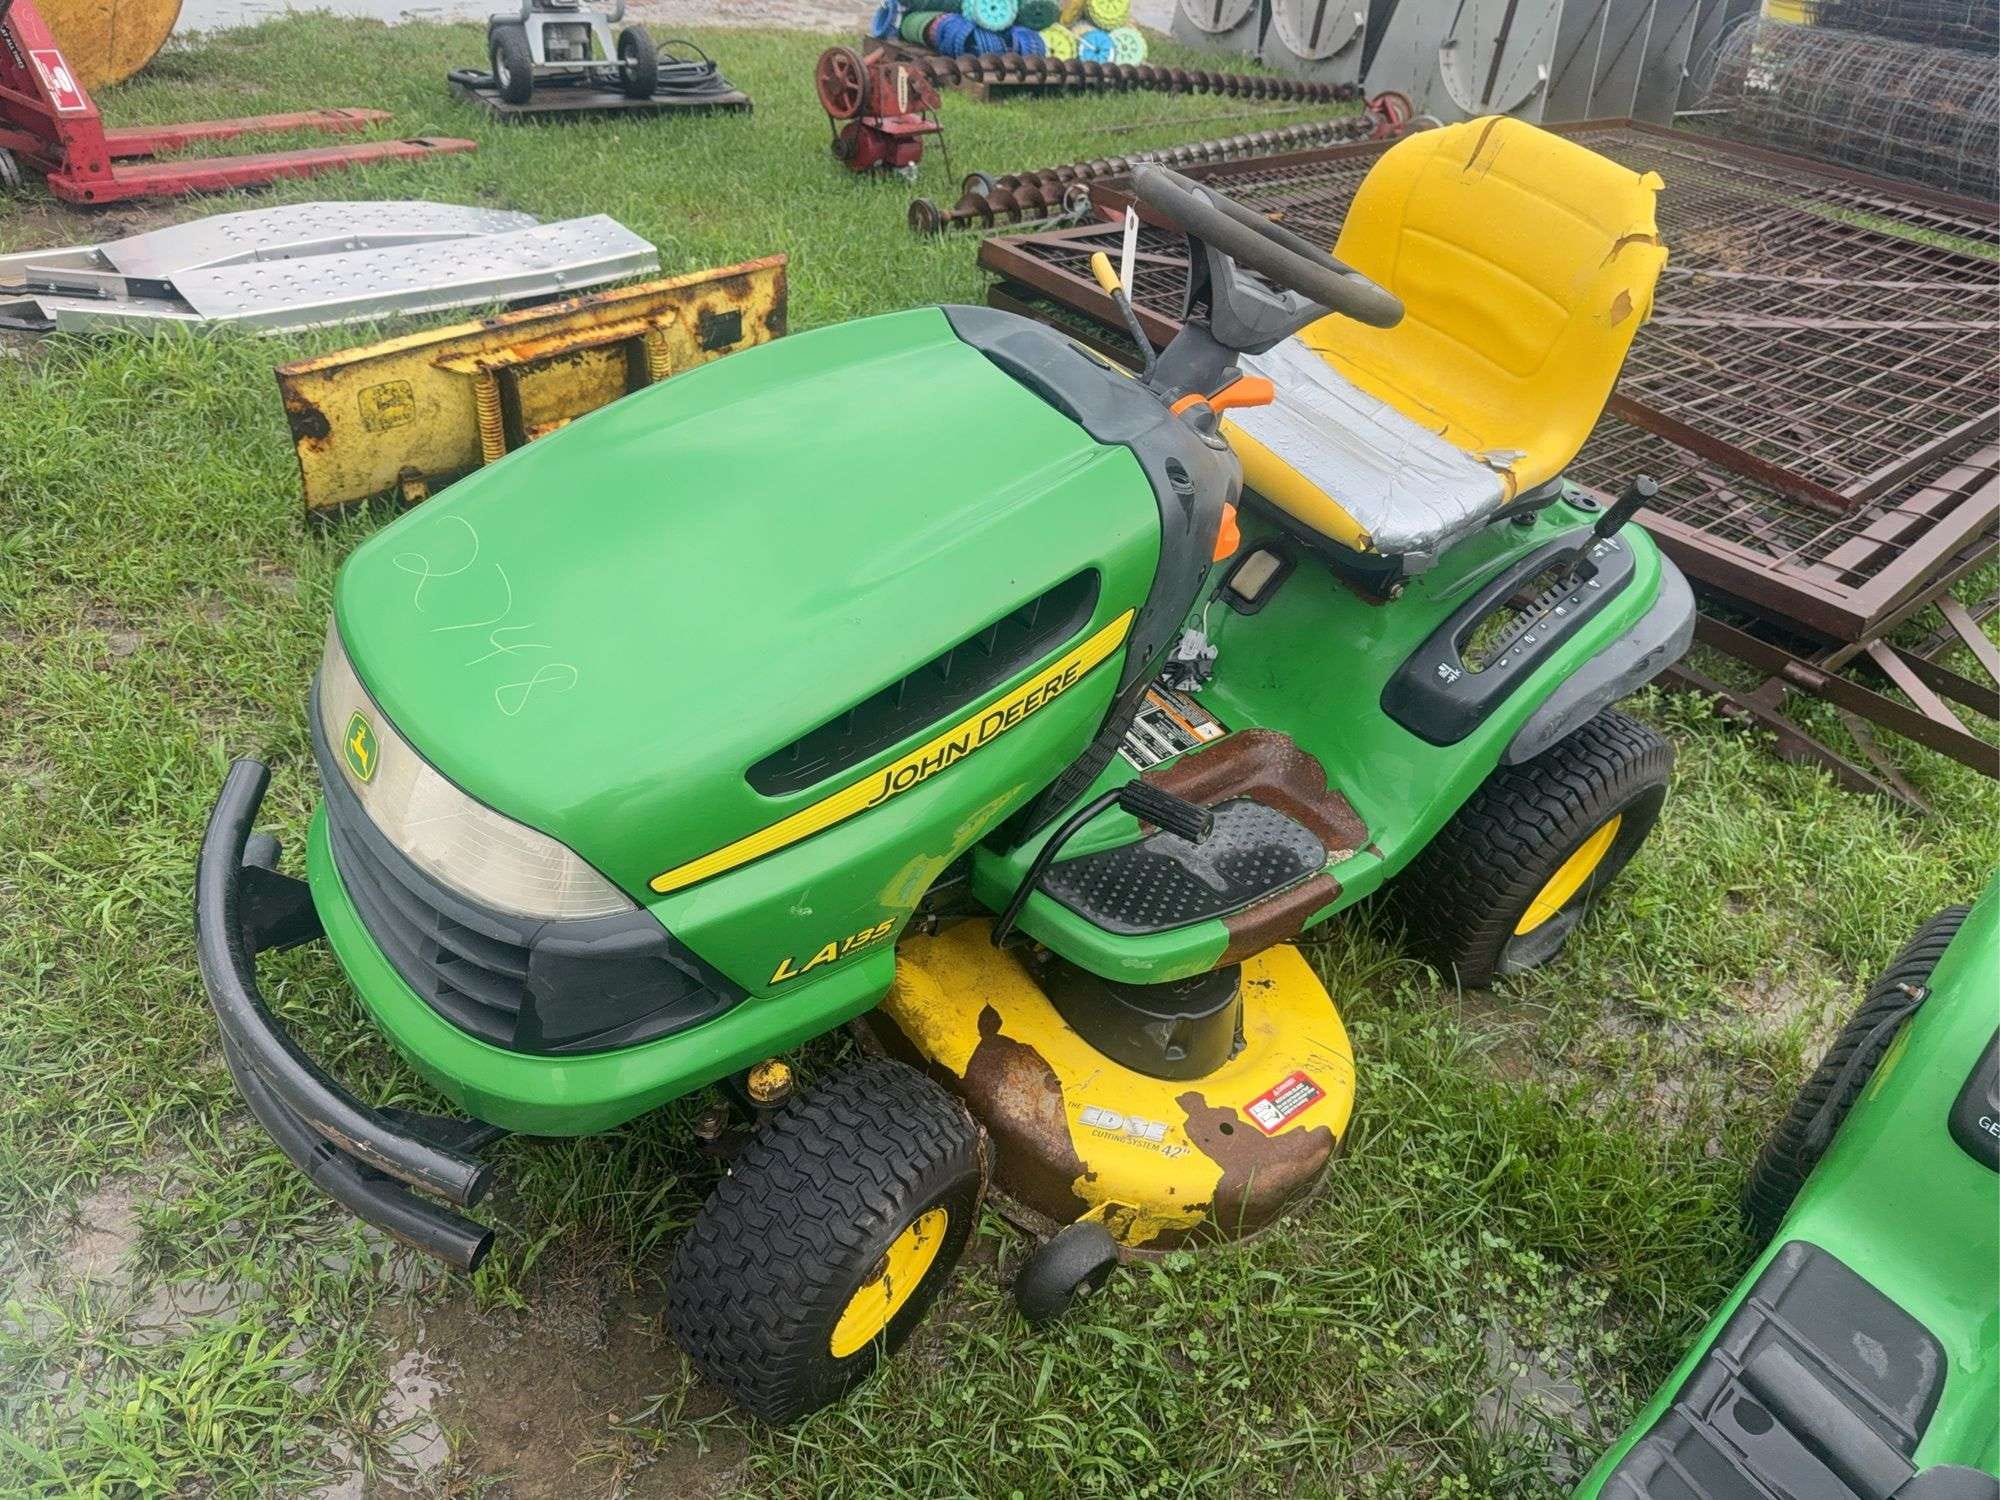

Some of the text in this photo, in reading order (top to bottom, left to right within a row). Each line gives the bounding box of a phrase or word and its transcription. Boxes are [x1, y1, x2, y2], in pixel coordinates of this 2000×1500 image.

[868, 732, 971, 805] JOHN
[977, 661, 1081, 744] DEERE
[1979, 1116, 2000, 1138] GE
[1091, 1128, 1126, 1145] CUTTING
[1126, 1135, 1160, 1152] SYSTEM
